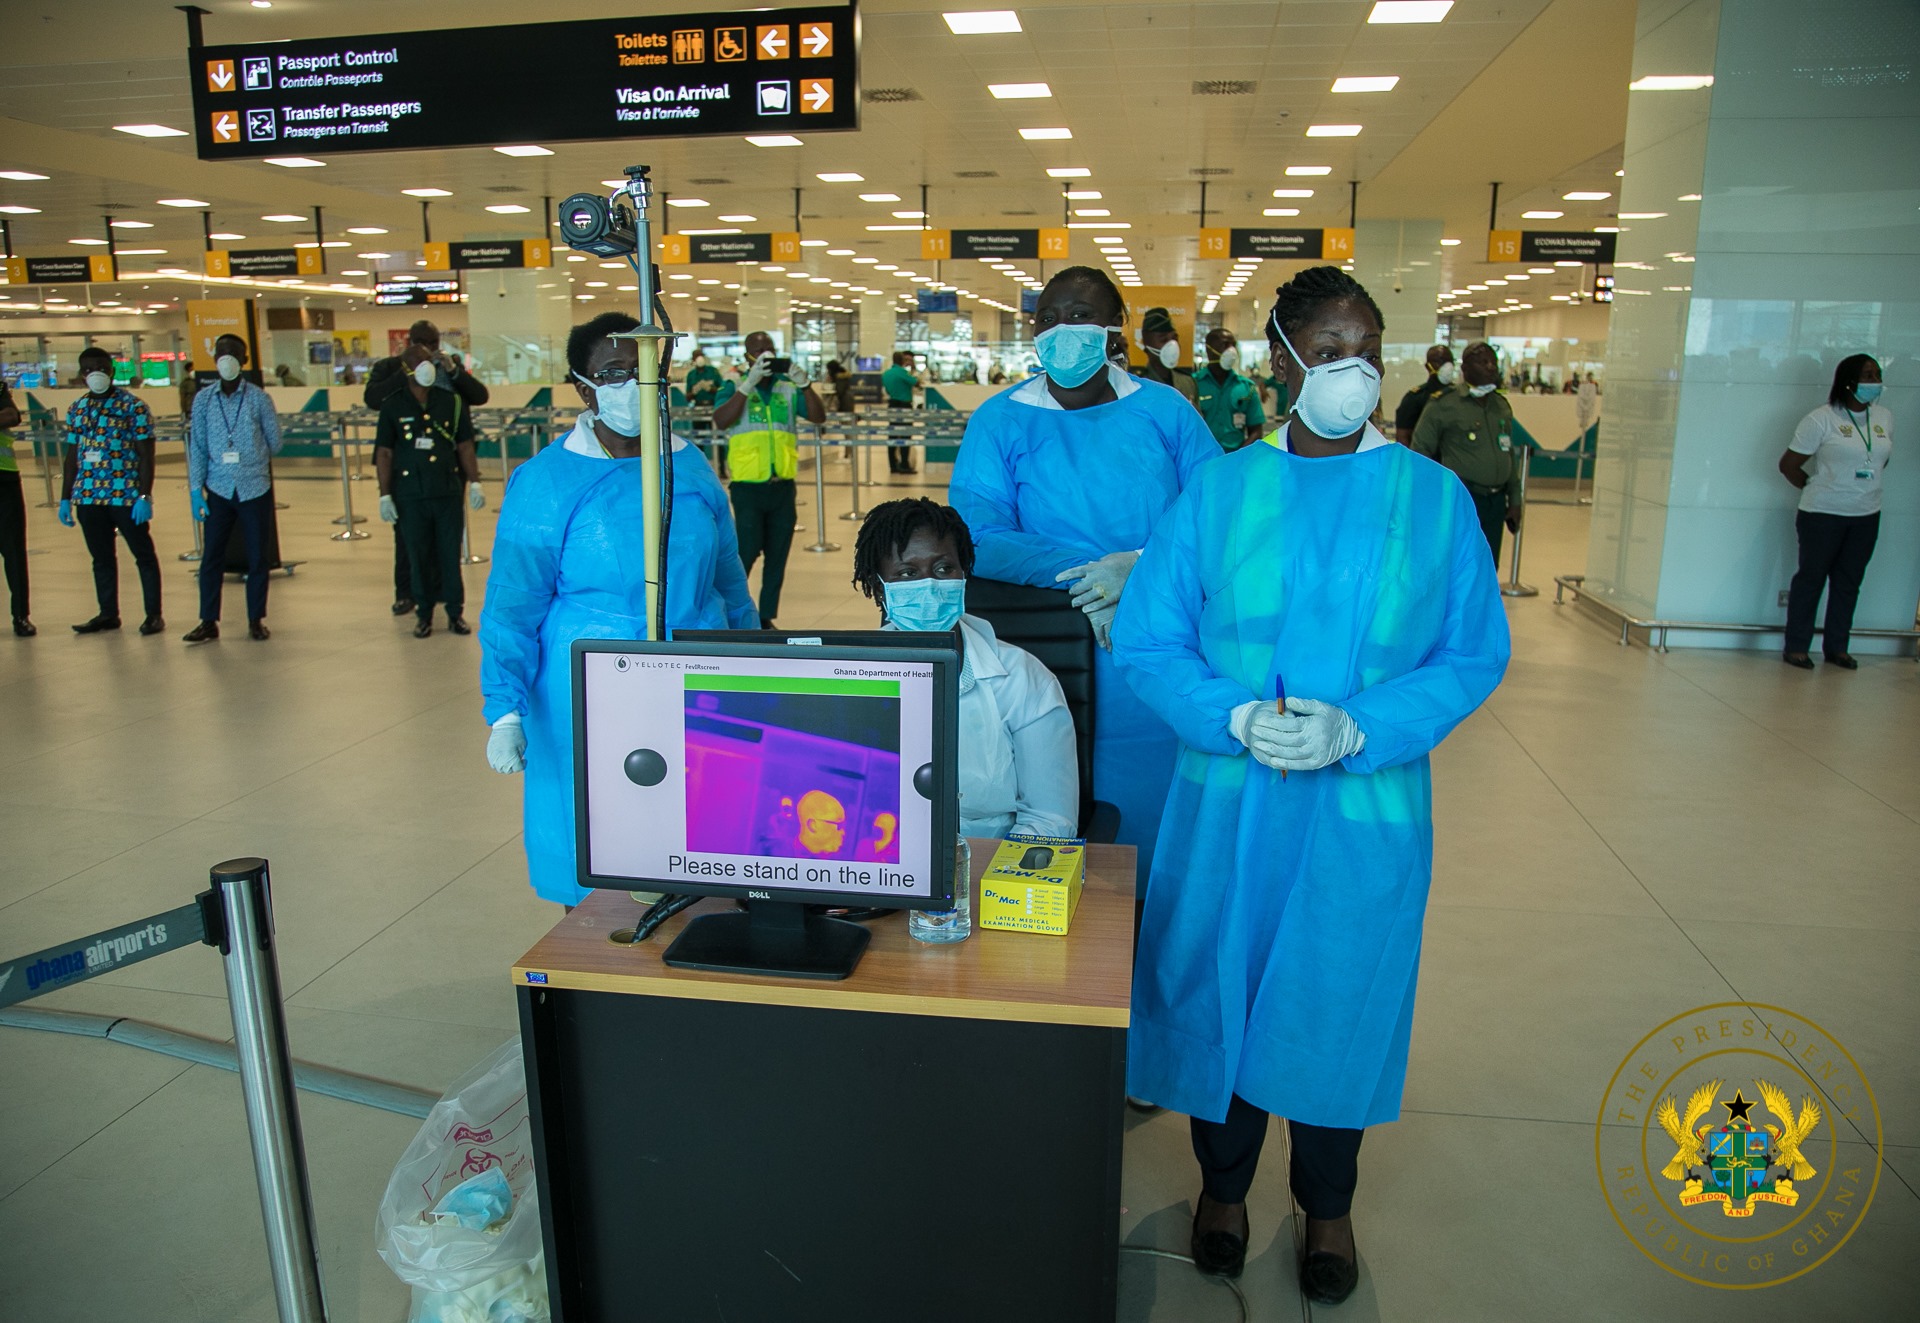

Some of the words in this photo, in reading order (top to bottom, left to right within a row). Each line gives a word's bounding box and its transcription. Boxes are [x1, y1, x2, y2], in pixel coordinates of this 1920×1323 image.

[614, 32, 668, 49] Toilets
[278, 53, 340, 72] Passport
[345, 48, 398, 66] Control
[618, 54, 668, 66] Toilettes
[280, 74, 324, 88] Contrôle
[324, 72, 384, 86] Passeports
[616, 88, 651, 104] Visa
[653, 86, 674, 102] On
[676, 83, 730, 101] Arrival
[282, 104, 339, 121] Transfer
[342, 101, 422, 119] Passengers
[616, 108, 641, 121] Visa
[642, 108, 651, 120] à
[652, 106, 700, 120] l'arrivée
[284, 125, 336, 140] Passagers
[338, 126, 350, 134] en
[352, 120, 389, 134] Transit
[928, 238, 944, 250] 11
[988, 236, 1020, 244] Nationals
[1046, 238, 1062, 250] 12
[1208, 238, 1224, 250] 13
[1250, 236, 1270, 244] Other
[1270, 236, 1304, 244] Nationals
[1330, 238, 1347, 250] 14
[532, 248, 541, 259] 8
[672, 244, 680, 256] 9
[778, 242, 794, 254] 10
[1496, 241, 1514, 254] 15
[306, 256, 313, 266] 6
[433, 251, 440, 262] 7
[98, 264, 105, 274] 4
[214, 259, 222, 270] 5
[14, 266, 20, 276] 3
[204, 318, 239, 326] Information
[317, 313, 324, 326] 2
[859, 669, 901, 678] Department
[668, 855, 736, 877] Please
[744, 862, 799, 881] stand
[806, 867, 831, 883] on
[839, 866, 871, 885] the
[879, 868, 915, 888] line
[992, 868, 1036, 877] Mac
[1036, 875, 1064, 884] Dr.
[749, 891, 770, 899] DELL
[984, 890, 998, 898] Dr.
[999, 896, 1020, 905] Mac
[984, 920, 1033, 929] EXAMINATION
[26, 950, 86, 990] ghana
[86, 924, 168, 968] airports
[89, 961, 114, 974] LIMITED
